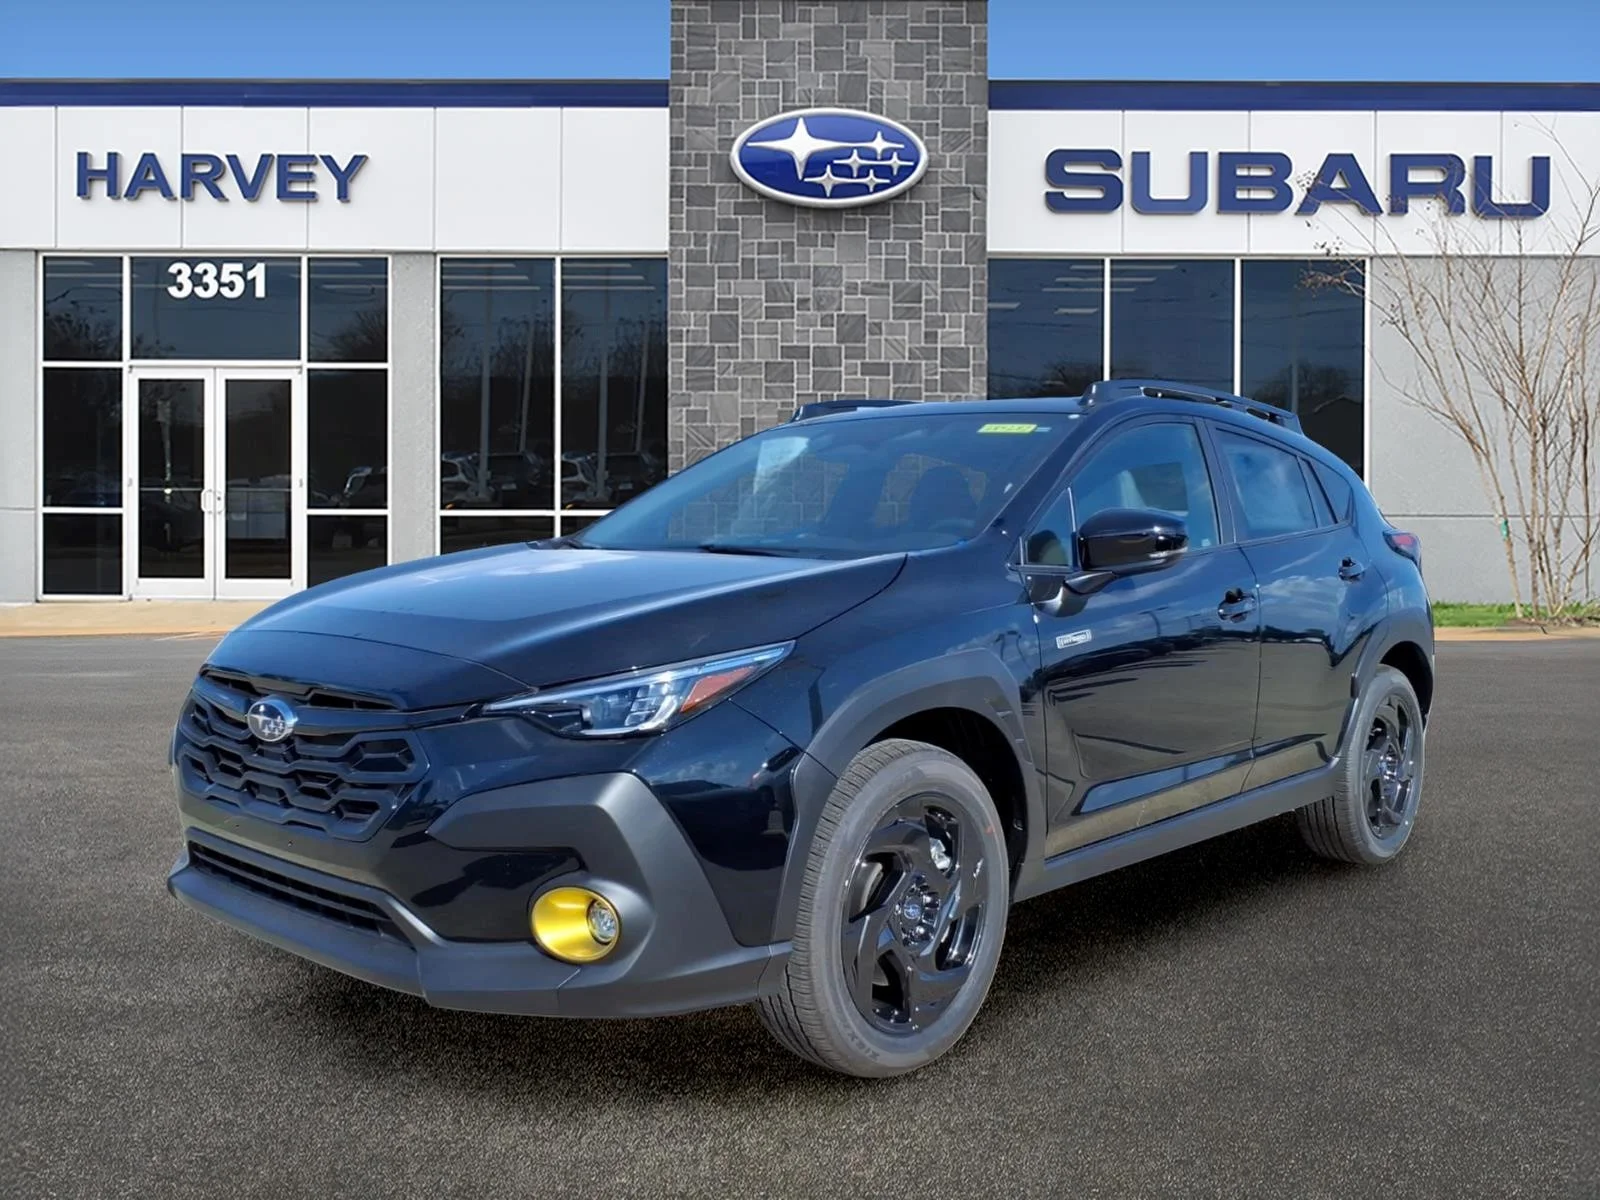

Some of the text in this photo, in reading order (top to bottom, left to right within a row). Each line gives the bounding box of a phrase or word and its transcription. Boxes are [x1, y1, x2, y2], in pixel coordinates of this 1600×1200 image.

[76, 151, 369, 203] HARVEY
[1044, 148, 1552, 218] SUBARU
[167, 262, 267, 299] 3351
